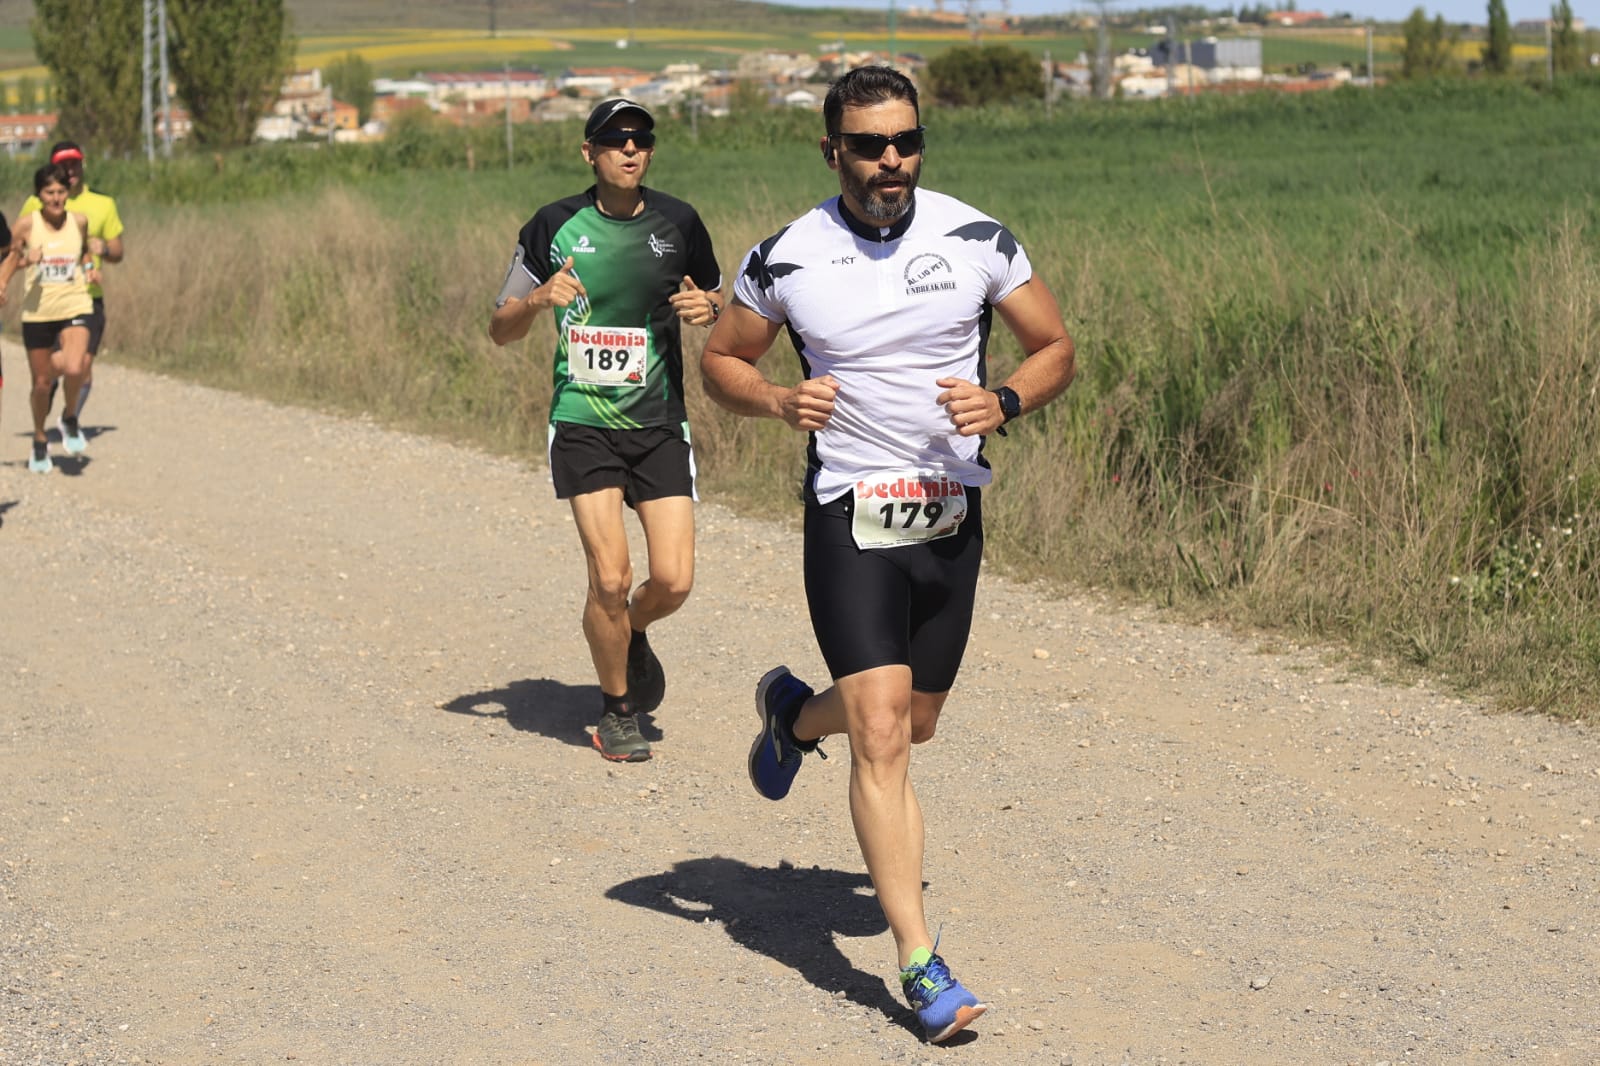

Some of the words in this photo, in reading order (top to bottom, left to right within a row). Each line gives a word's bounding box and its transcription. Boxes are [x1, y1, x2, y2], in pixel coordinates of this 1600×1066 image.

[570, 329, 645, 347] bedunia
[584, 348, 630, 371] 189
[856, 477, 964, 499] bedunia
[879, 502, 944, 529] 179
